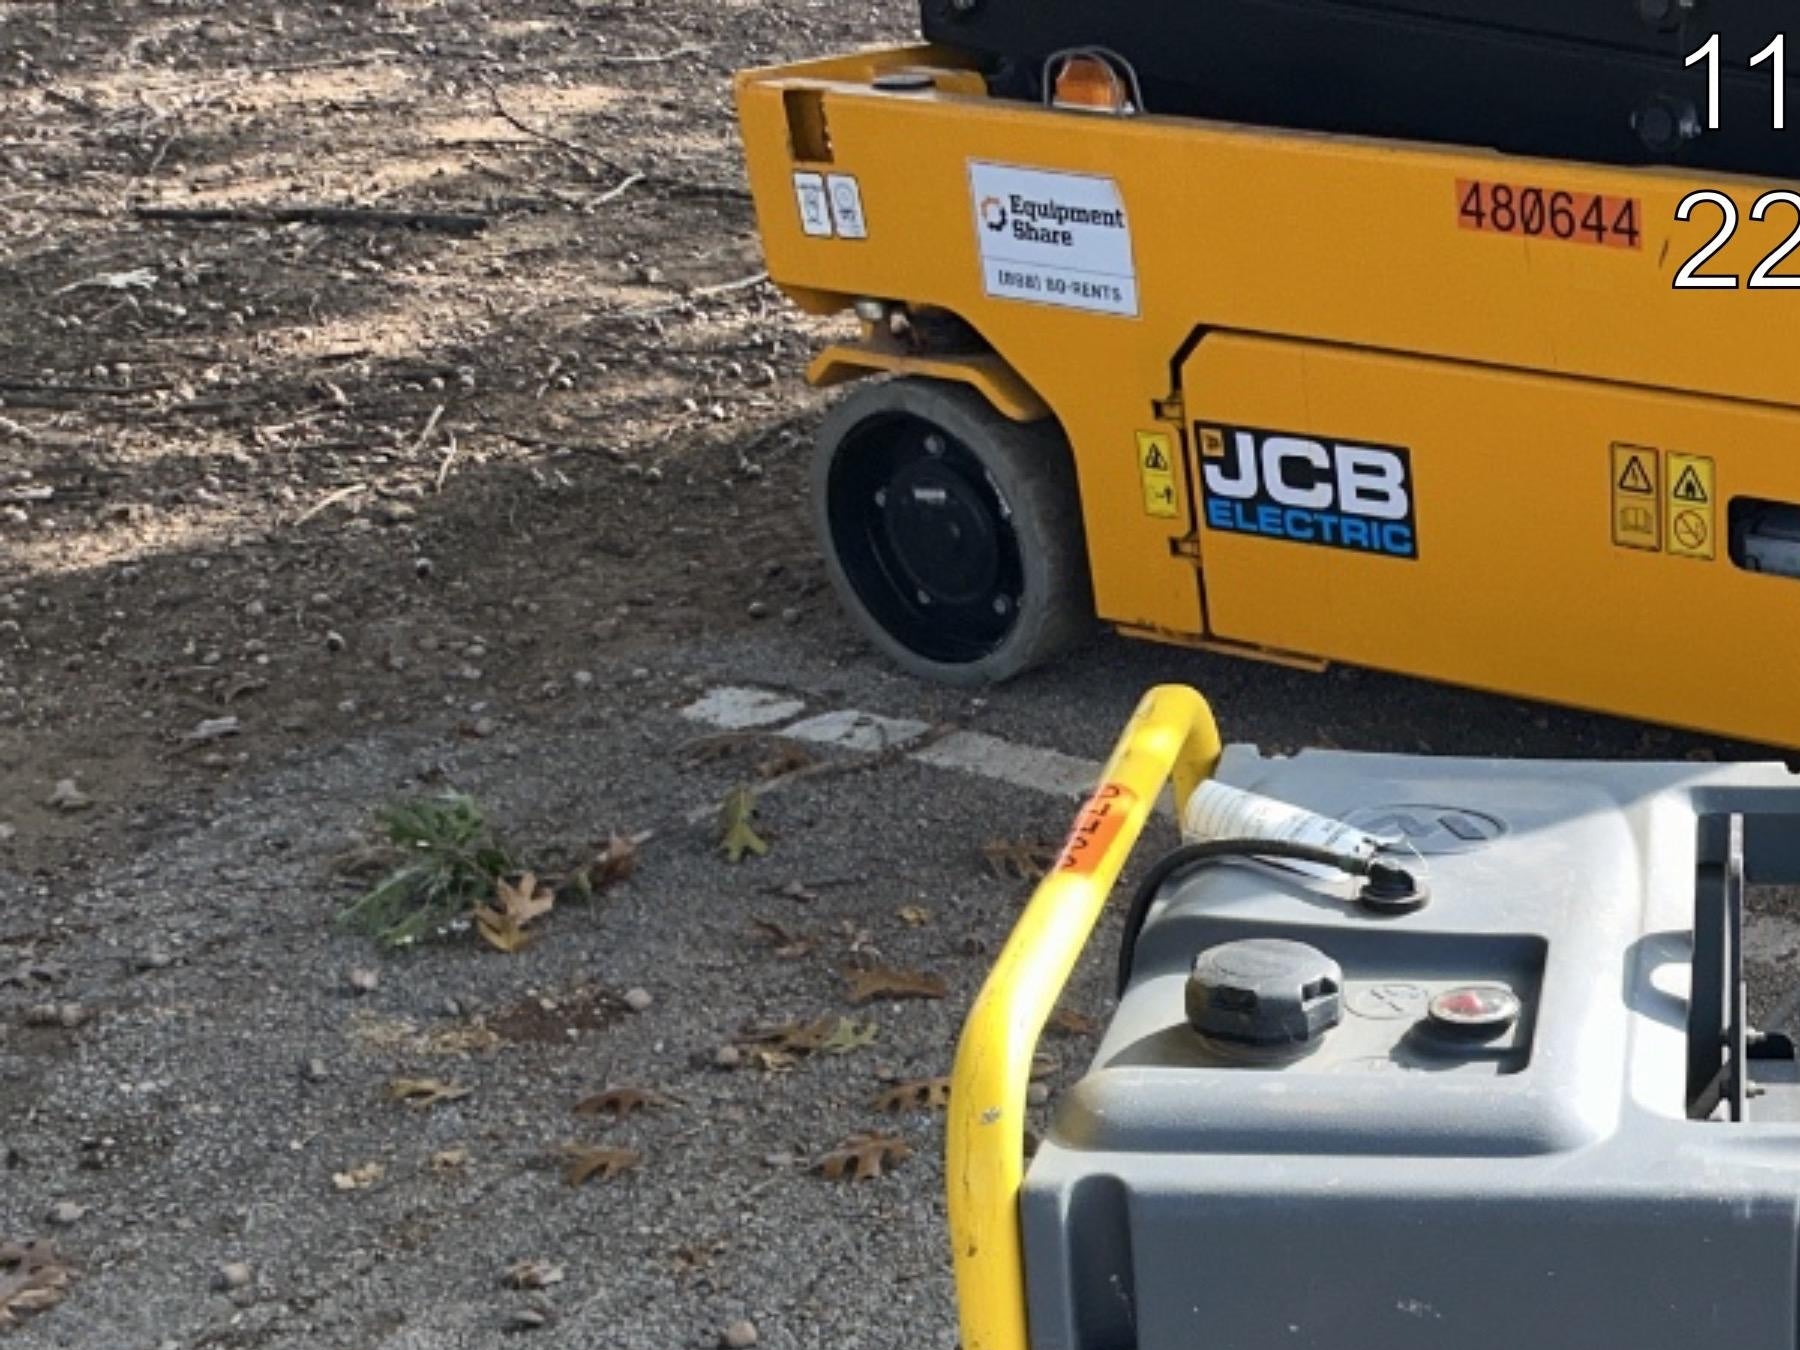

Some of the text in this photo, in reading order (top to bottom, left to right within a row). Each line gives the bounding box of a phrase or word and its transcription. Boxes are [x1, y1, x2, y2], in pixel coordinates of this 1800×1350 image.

[1008, 193, 1126, 229] Equipment
[1012, 218, 1074, 247] Share
[1460, 181, 1640, 246] 480644
[1203, 430, 1409, 520] JCB
[1206, 497, 1414, 556] ELECTRIC
